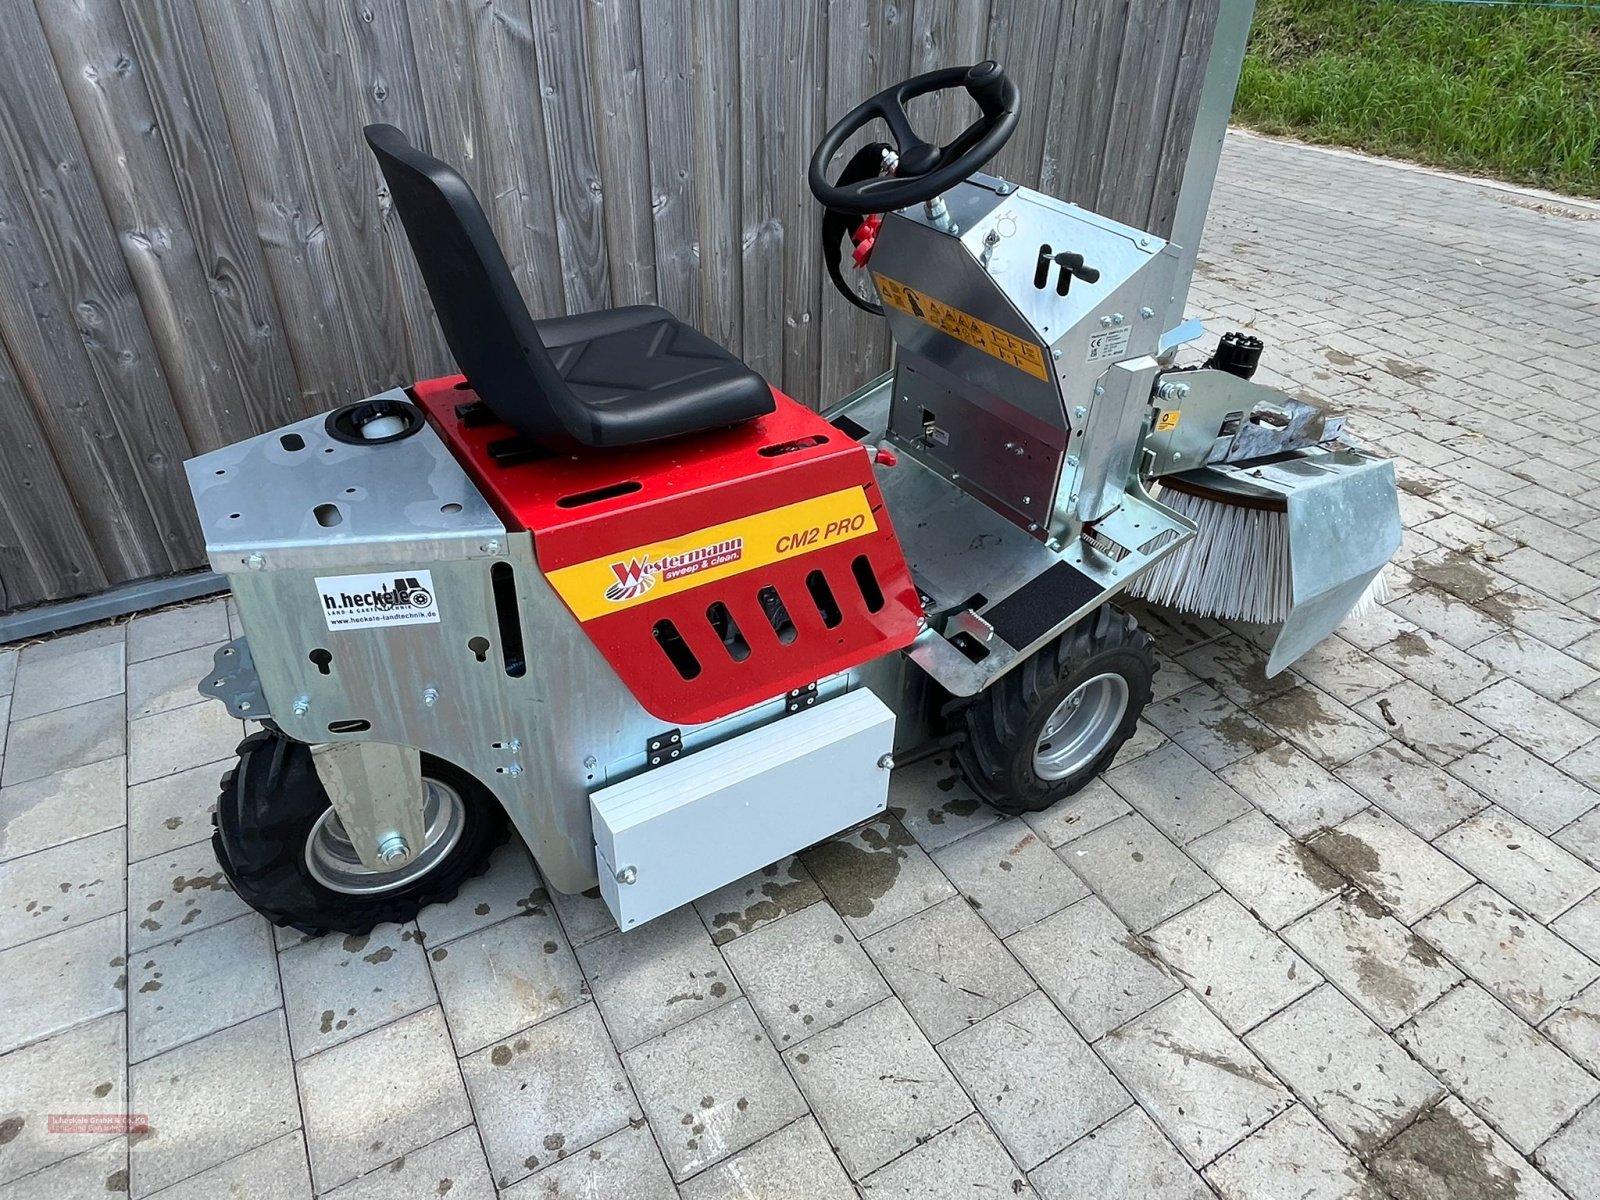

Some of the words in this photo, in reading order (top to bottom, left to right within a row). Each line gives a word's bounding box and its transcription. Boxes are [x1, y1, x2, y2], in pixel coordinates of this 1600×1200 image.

[775, 530, 819, 554] CM2
[824, 513, 865, 540] PRO
[611, 537, 743, 587] Westermann
[665, 563, 700, 580] sweep
[701, 558, 709, 568] &
[710, 551, 740, 566] clean.
[323, 589, 411, 610] h.heckele
[330, 611, 437, 625] www.heckele-landtechnik.de
